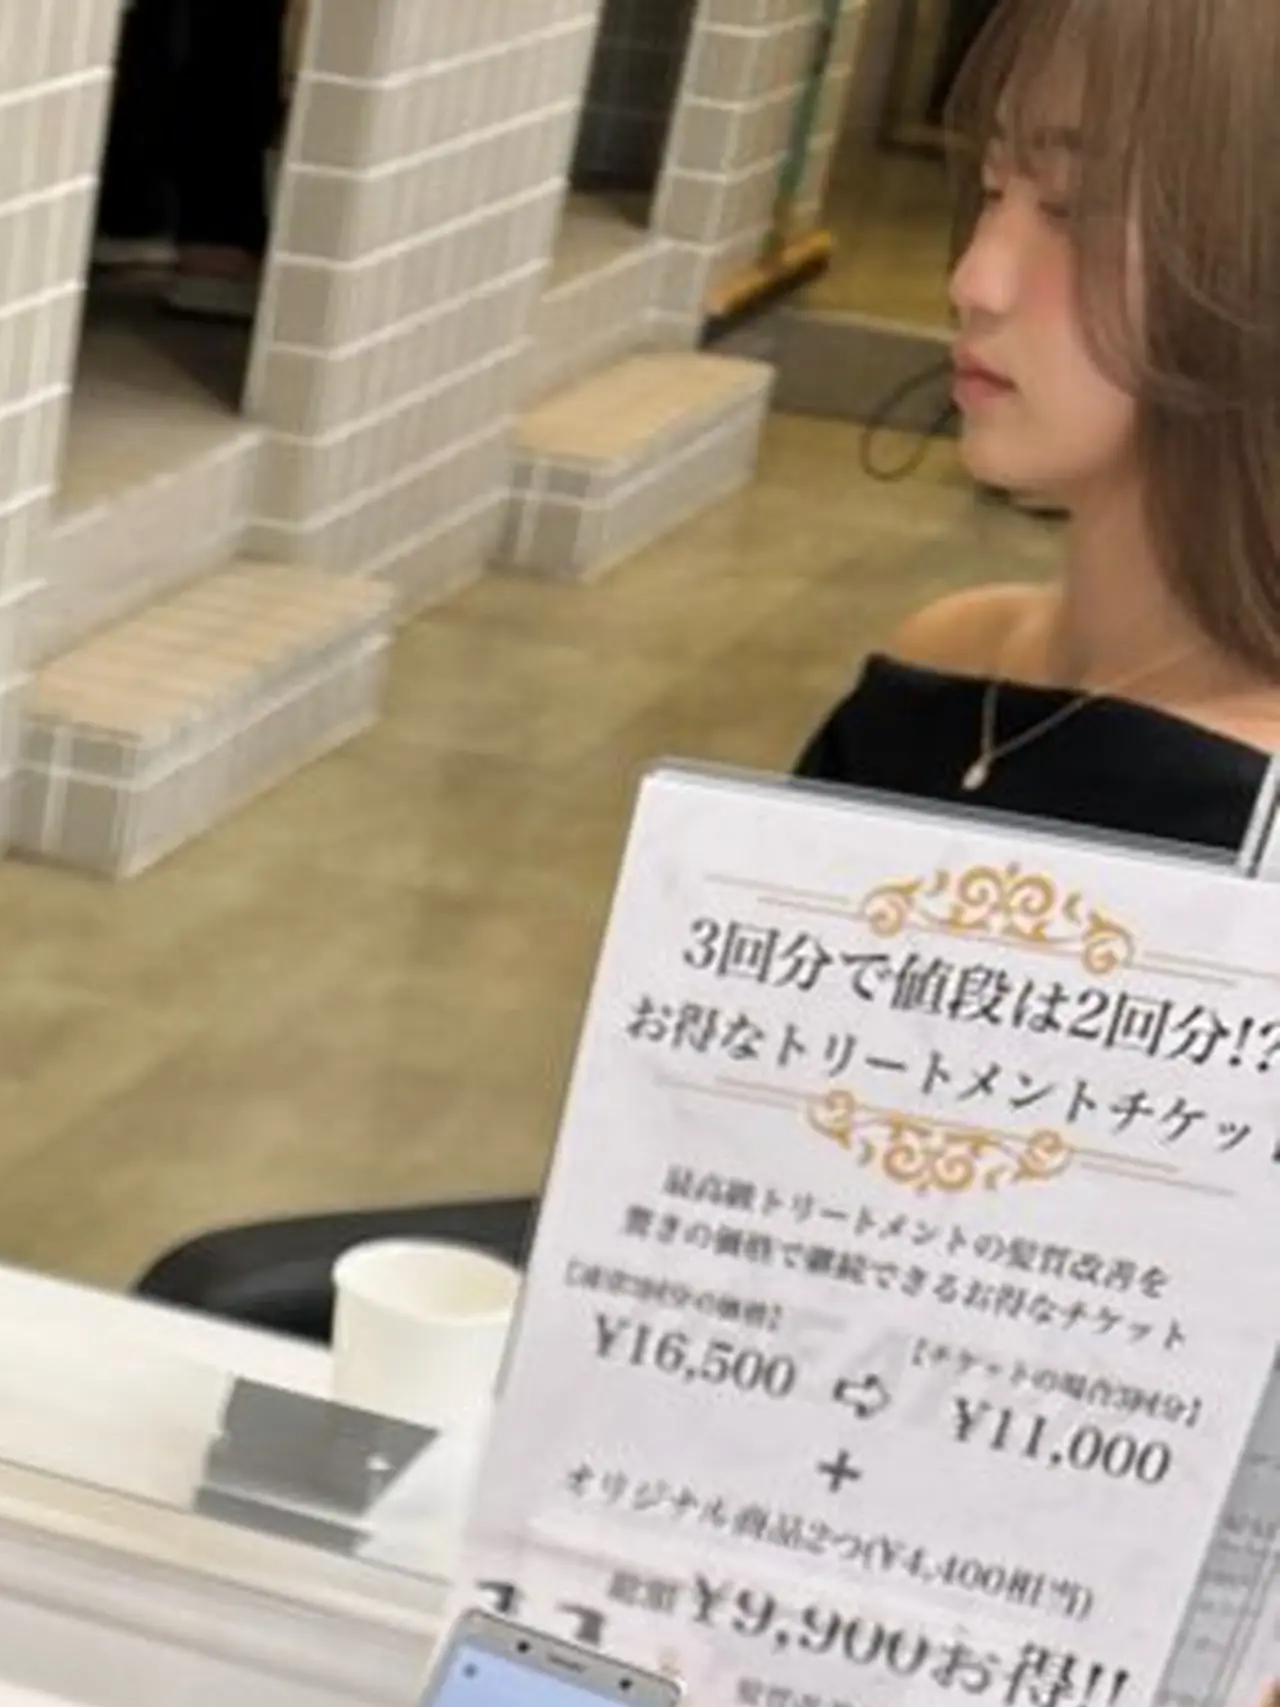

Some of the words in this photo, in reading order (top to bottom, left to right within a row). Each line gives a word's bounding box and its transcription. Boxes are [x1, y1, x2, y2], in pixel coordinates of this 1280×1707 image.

[626, 997, 1280, 1163] お得なトリートメントチケッ
[595, 1312, 796, 1397] ¥16,500
[954, 1397, 1171, 1484] ¥11,000
